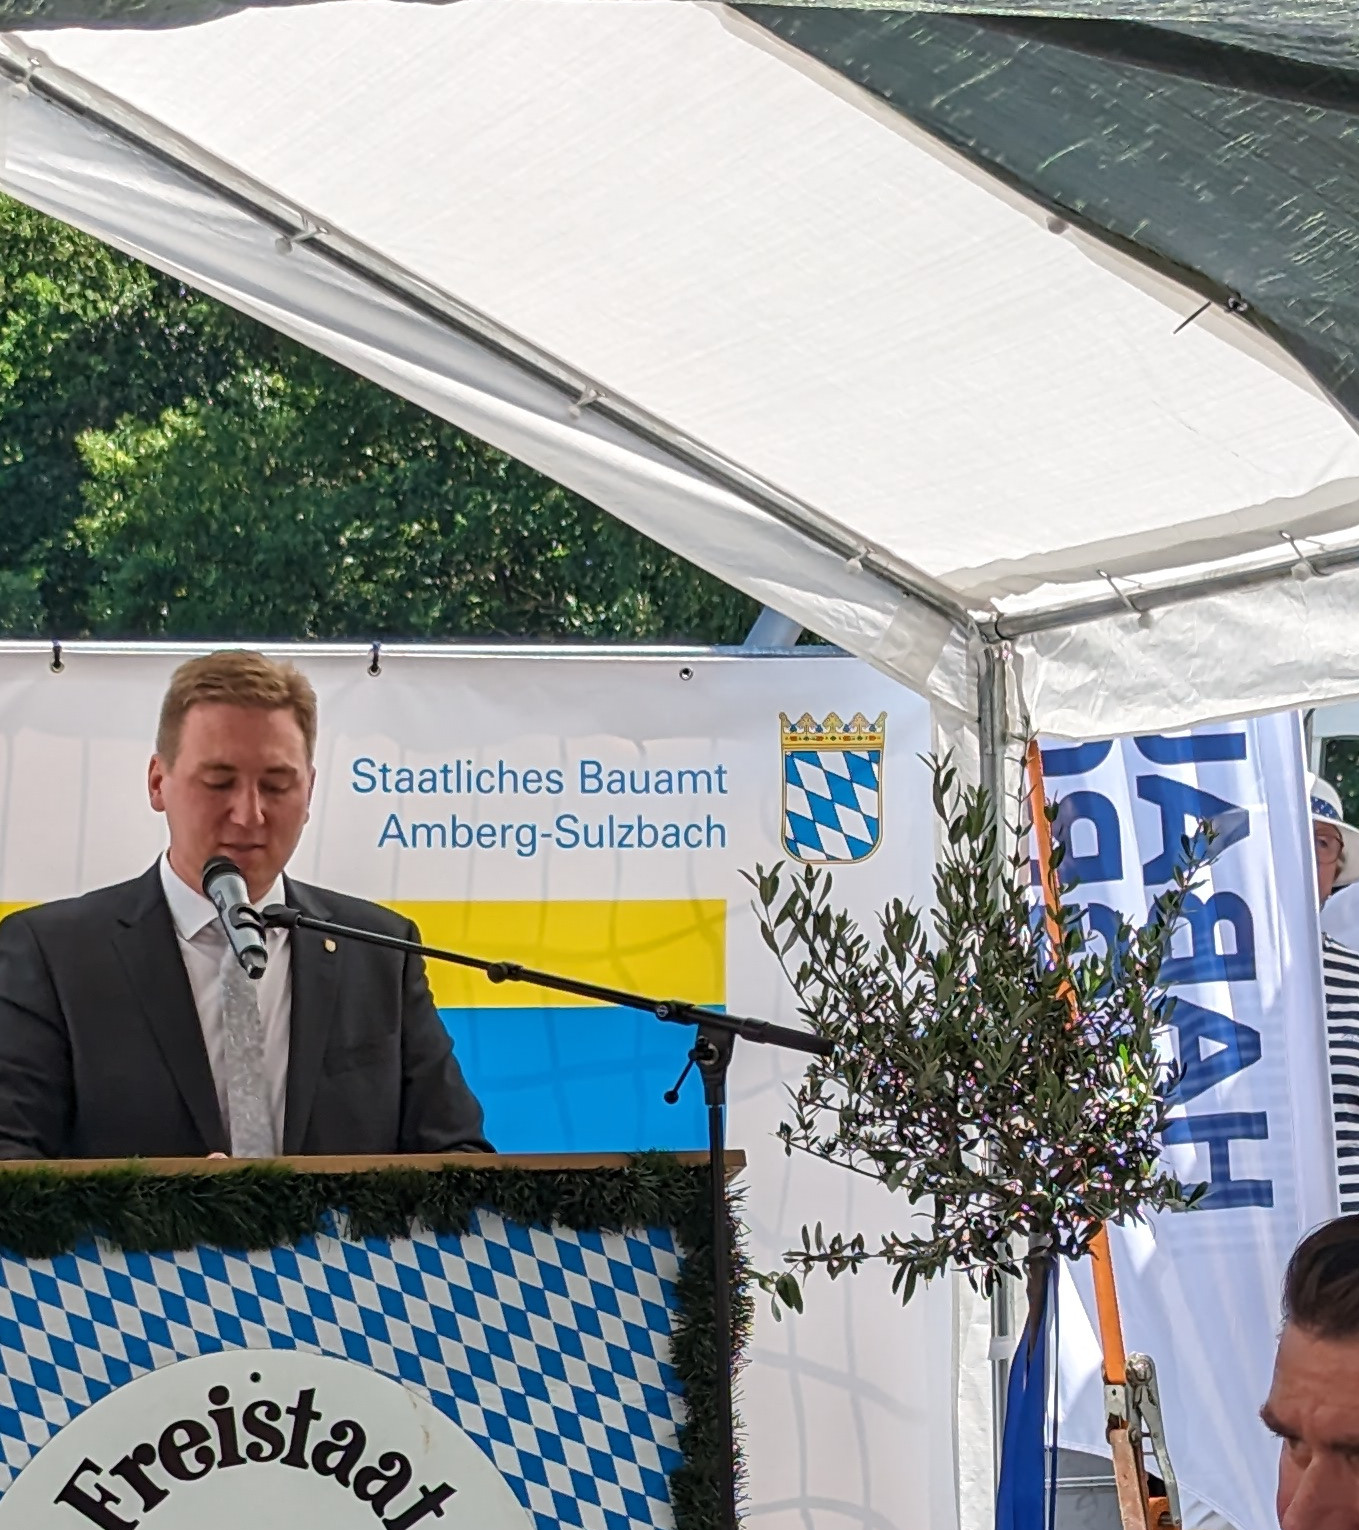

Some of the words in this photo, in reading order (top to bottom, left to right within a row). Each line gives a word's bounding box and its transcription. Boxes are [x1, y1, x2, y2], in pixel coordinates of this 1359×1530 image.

[351, 757, 565, 795] Staatliches
[579, 759, 729, 795] Bauamt
[377, 813, 727, 858] Amberg-Sulzbach
